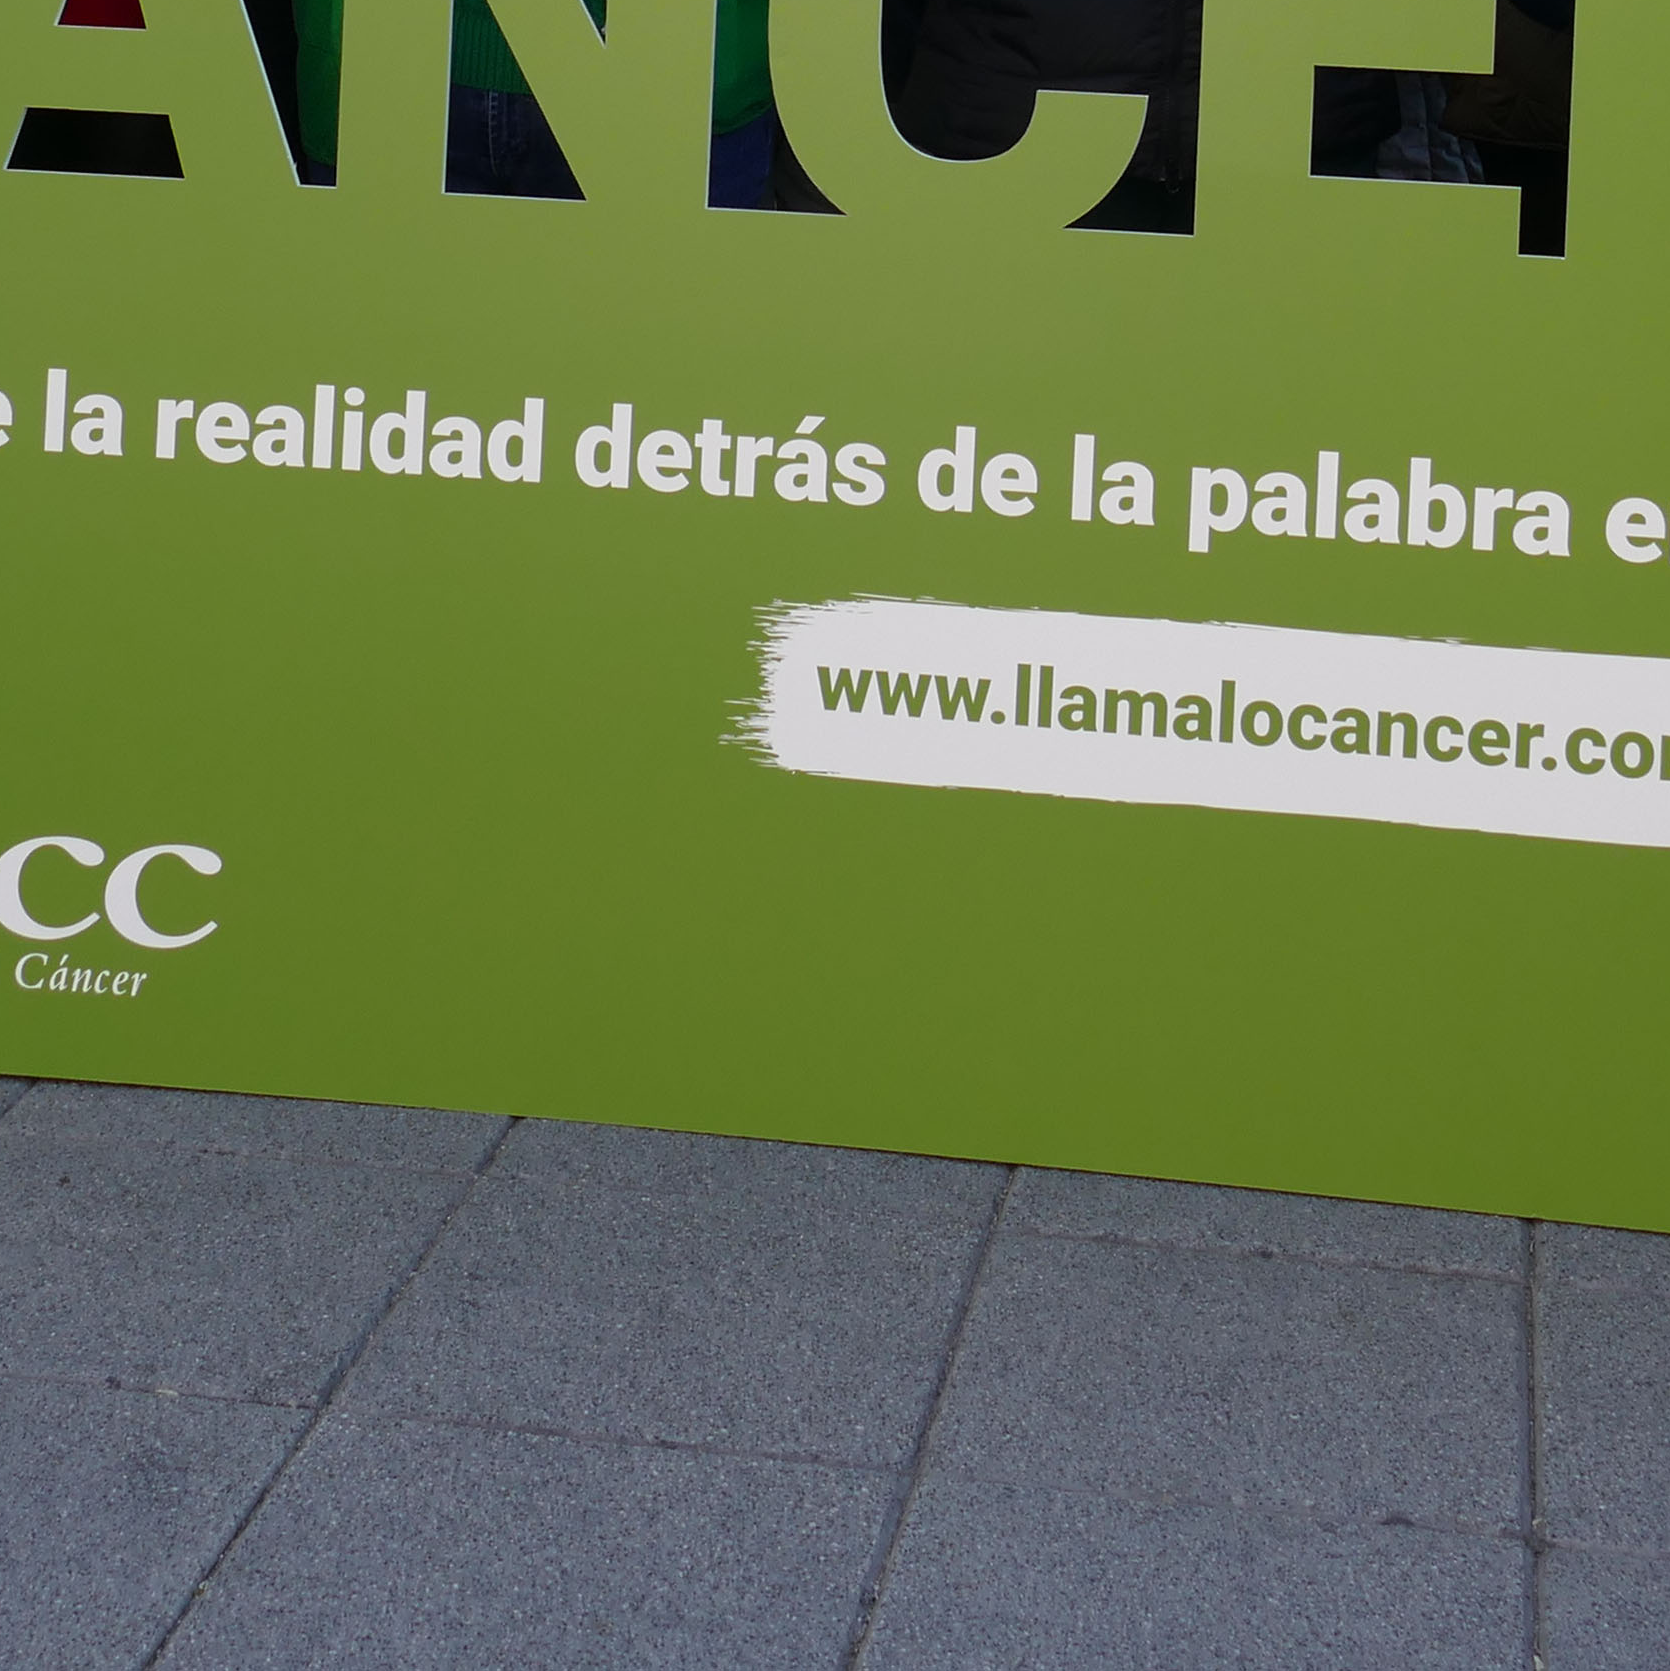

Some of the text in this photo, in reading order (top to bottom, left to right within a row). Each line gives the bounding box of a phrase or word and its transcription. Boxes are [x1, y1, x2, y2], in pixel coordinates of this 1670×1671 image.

[43, 367, 124, 457] la
[155, 383, 546, 484] realidad
[574, 402, 887, 507] detrás
[917, 424, 1039, 517] de
[1070, 433, 1155, 526] la
[1187, 450, 1571, 557] palabra
[14, 952, 148, 997] Cáncer
